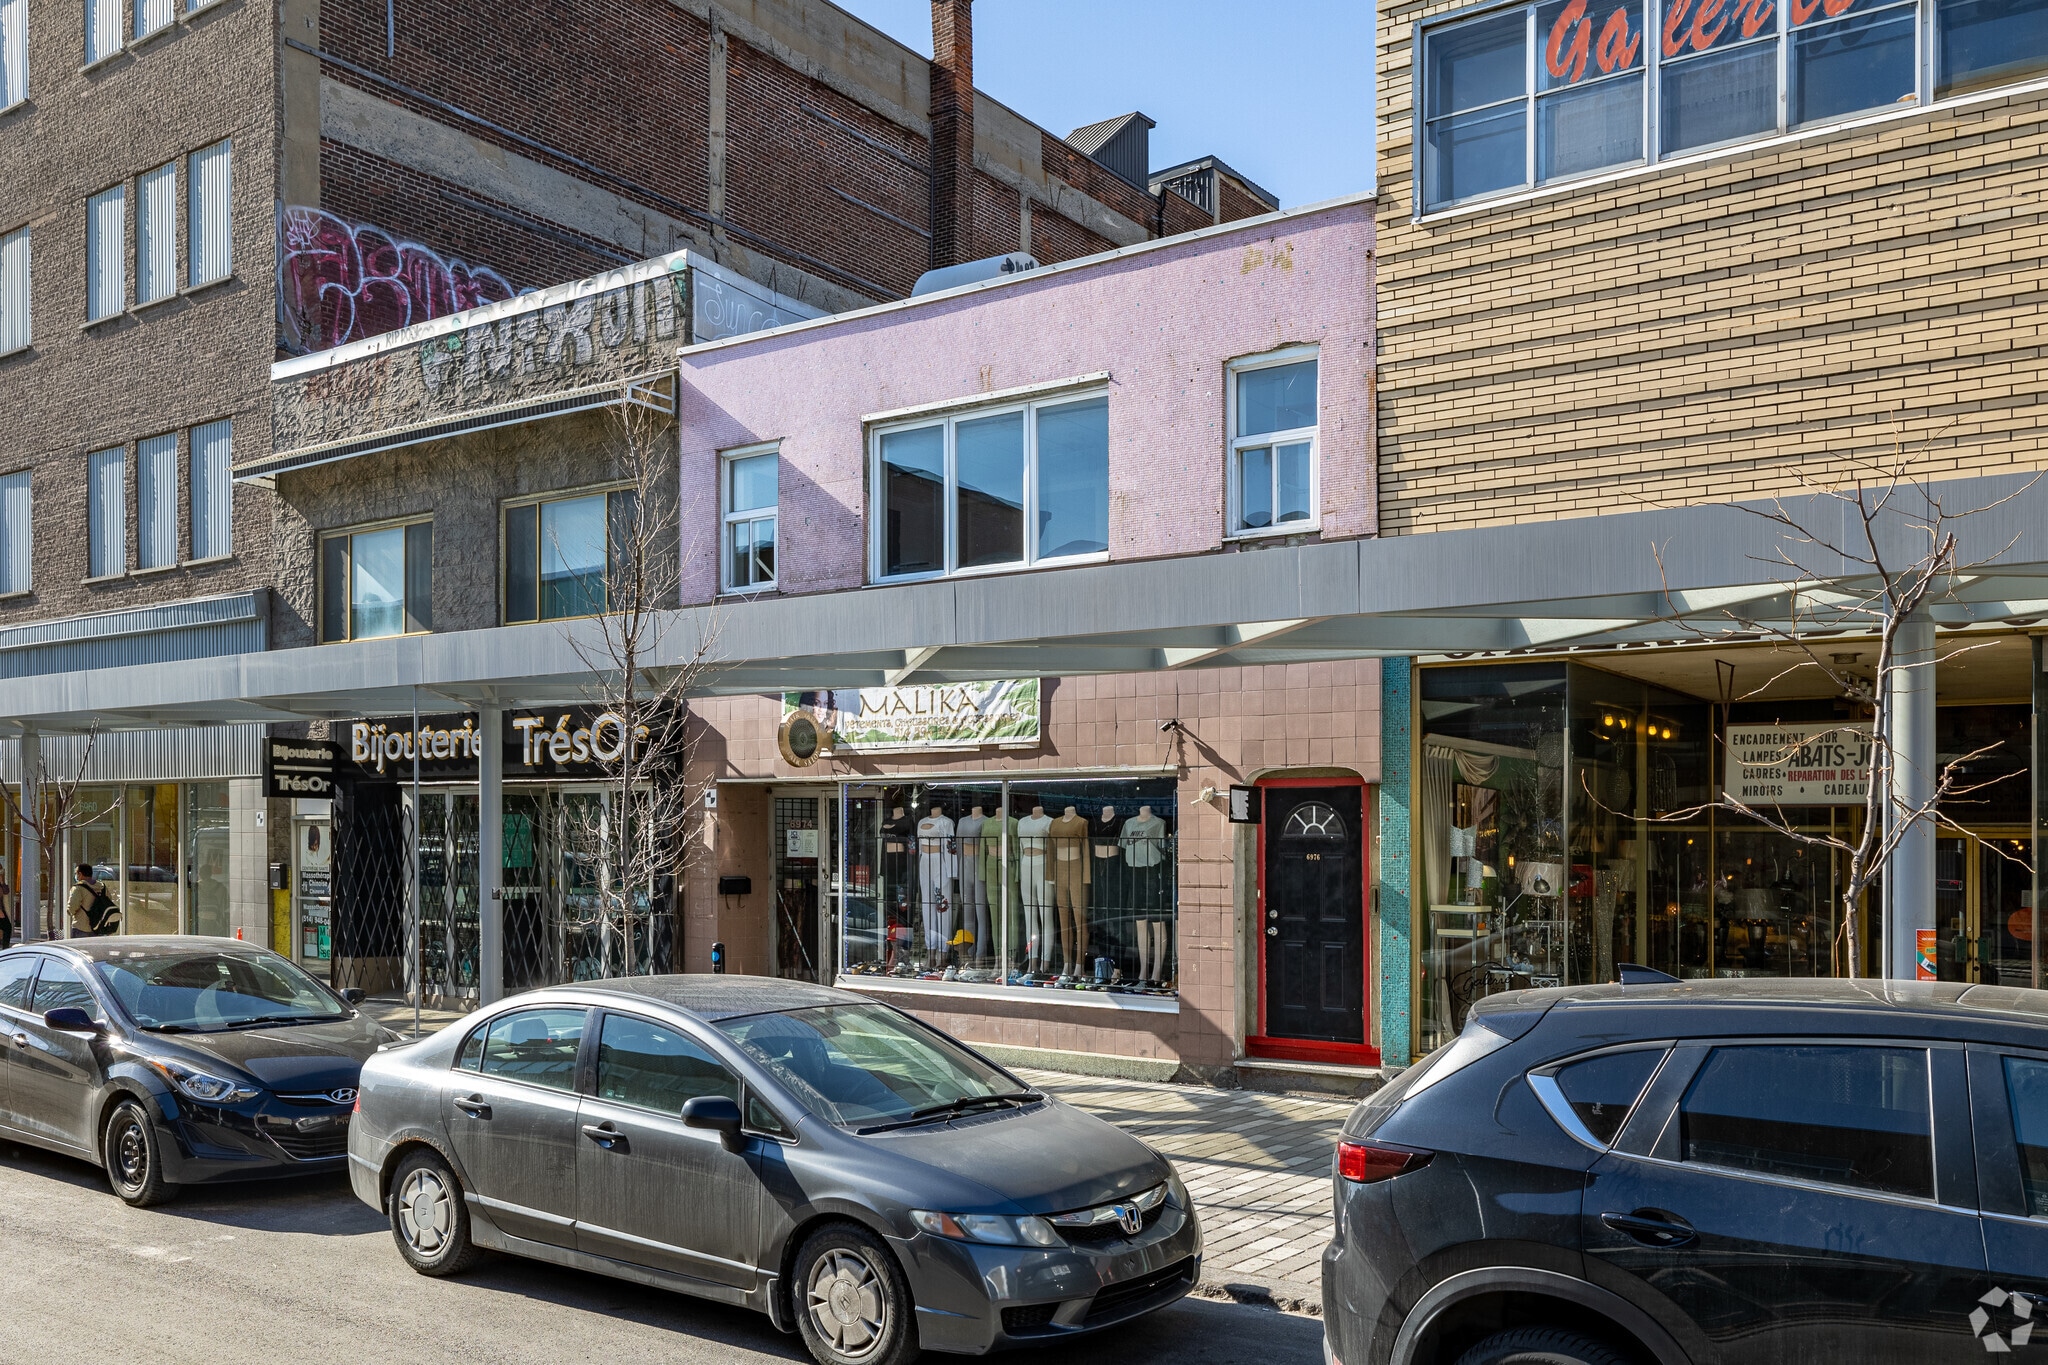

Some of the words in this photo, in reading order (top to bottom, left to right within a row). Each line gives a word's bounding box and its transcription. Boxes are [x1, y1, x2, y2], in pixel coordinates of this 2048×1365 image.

[1546, 0, 1852, 82] Galer
[859, 687, 979, 718] MALIKA
[512, 712, 651, 766] TrésOr
[1733, 732, 1806, 746] ENCADREMENT
[1818, 731, 1838, 744] SUR
[273, 744, 334, 761] Bijouterie
[1743, 750, 1782, 763] LAMPES
[1787, 743, 1874, 768] ABATS-JO
[275, 774, 331, 792] TrésOr
[1742, 768, 1782, 780] CADRES
[1787, 769, 1837, 782] REPARATION
[1840, 769, 1856, 781] DES
[1742, 785, 1783, 797] MIROIRS
[790, 819, 813, 829] 6974
[1306, 853, 1321, 861] 6976
